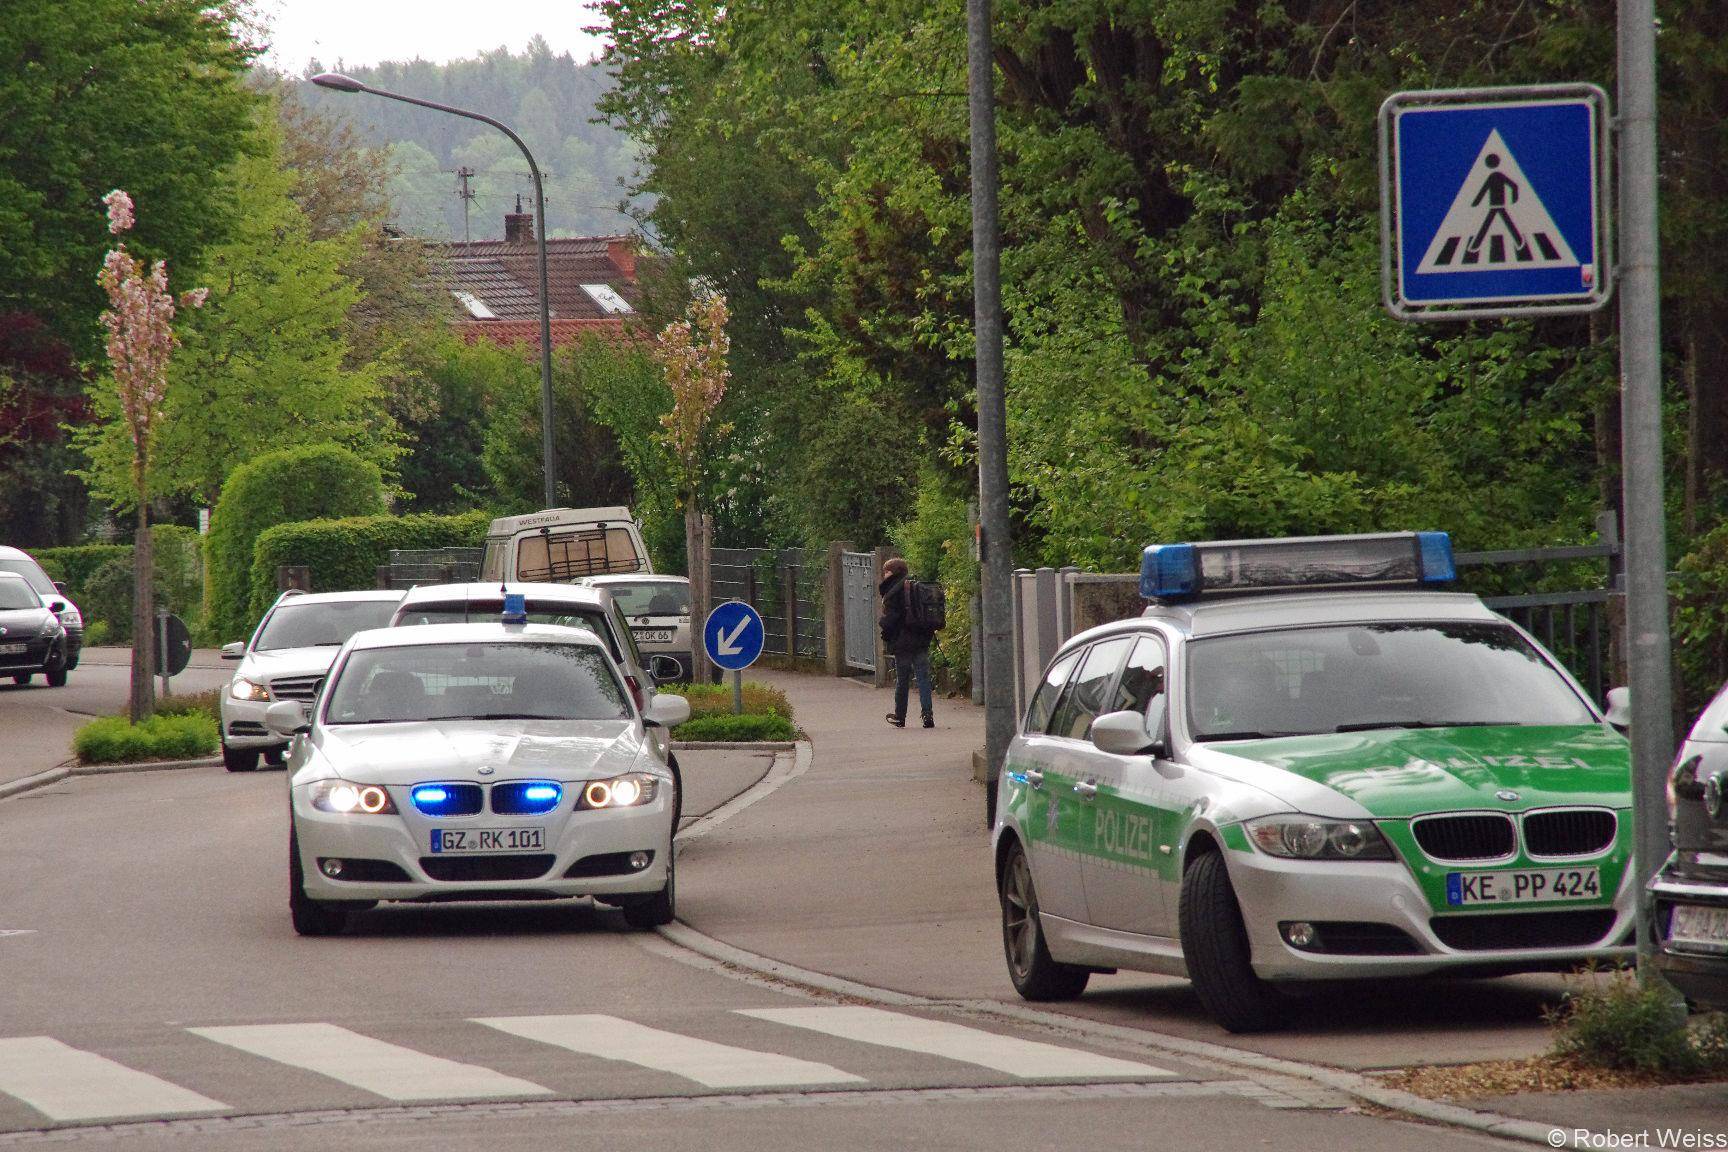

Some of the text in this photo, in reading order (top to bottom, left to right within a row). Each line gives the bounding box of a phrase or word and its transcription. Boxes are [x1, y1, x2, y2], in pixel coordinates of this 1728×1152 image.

[519, 515, 560, 526] WESTFALIA
[658, 631, 669, 640] 66
[442, 829, 542, 850] GZ RK 101
[1095, 806, 1153, 860] POLIZEI
[1462, 875, 1497, 901] KE
[1514, 873, 1547, 899] PP
[1552, 870, 1599, 897] 424
